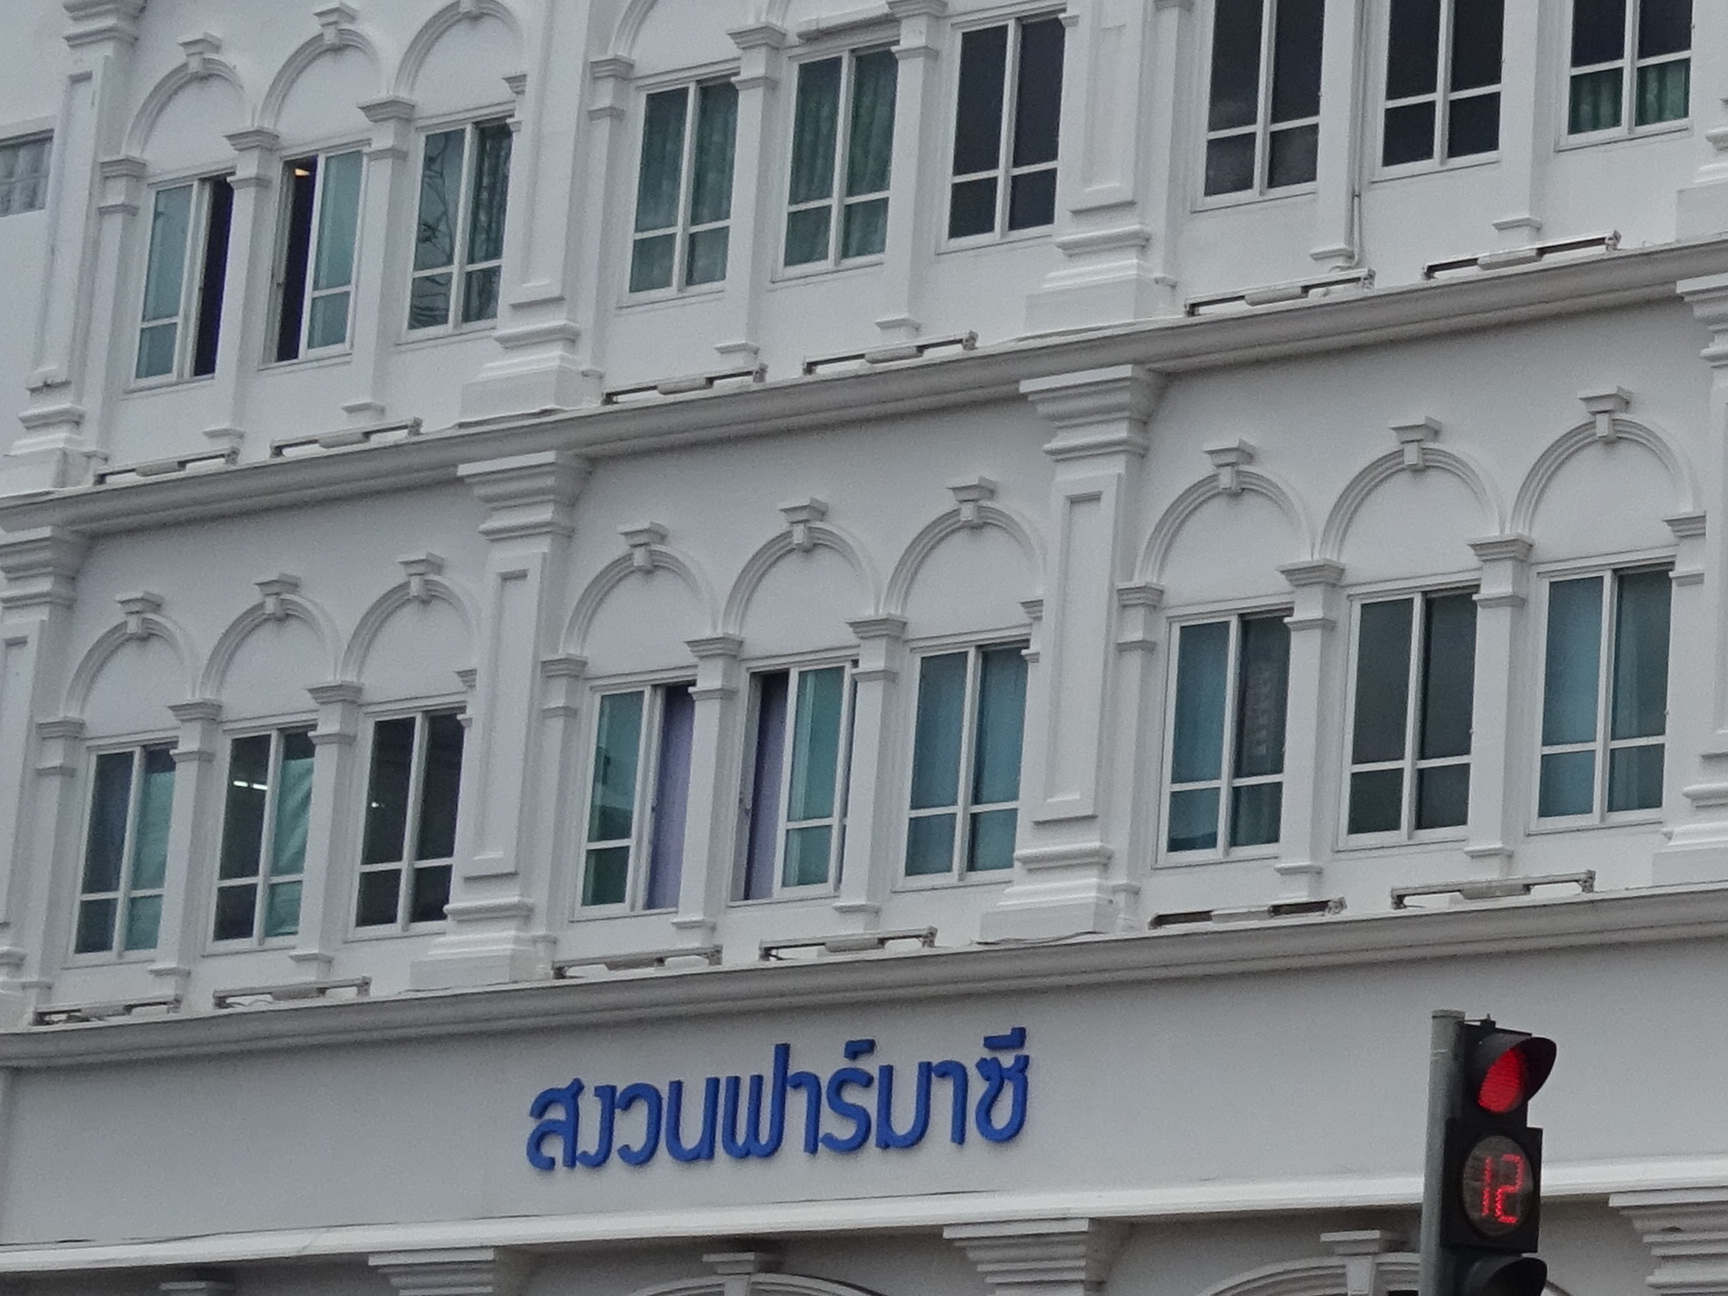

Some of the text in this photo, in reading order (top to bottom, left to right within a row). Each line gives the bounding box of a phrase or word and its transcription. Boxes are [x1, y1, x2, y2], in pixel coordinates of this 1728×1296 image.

[525, 1027, 1031, 1172] สงวนฟาร์มาซี
[1480, 1153, 1525, 1225] 12
